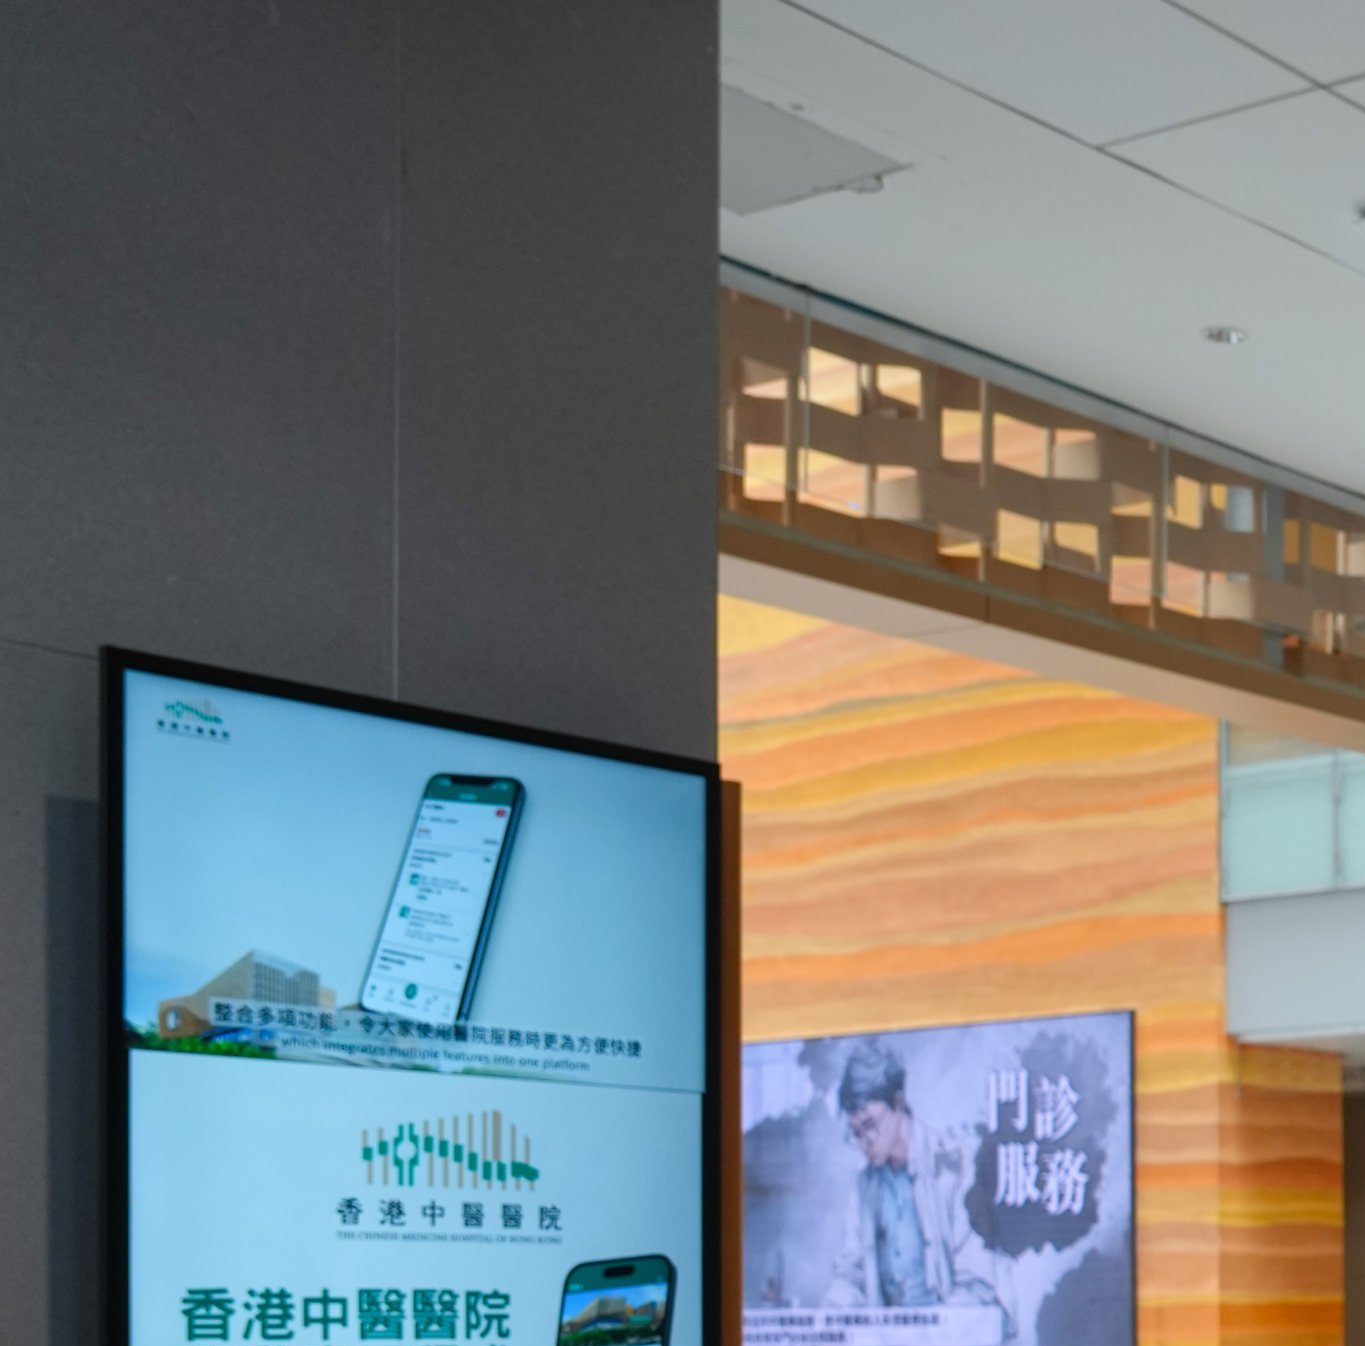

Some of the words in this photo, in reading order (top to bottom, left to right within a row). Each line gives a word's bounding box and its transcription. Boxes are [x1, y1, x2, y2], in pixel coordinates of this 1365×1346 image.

[281, 1036, 320, 1049] which
[323, 1039, 386, 1056] integrates
[443, 1050, 490, 1065] features
[494, 1053, 515, 1066] into
[518, 1057, 538, 1067] one
[543, 1057, 590, 1072] platform
[986, 1069, 1080, 1142] 門診
[994, 1143, 1090, 1216] 服務
[336, 1197, 562, 1230] 香港中醫醫院
[181, 1287, 511, 1342] 香港中醫醫院
